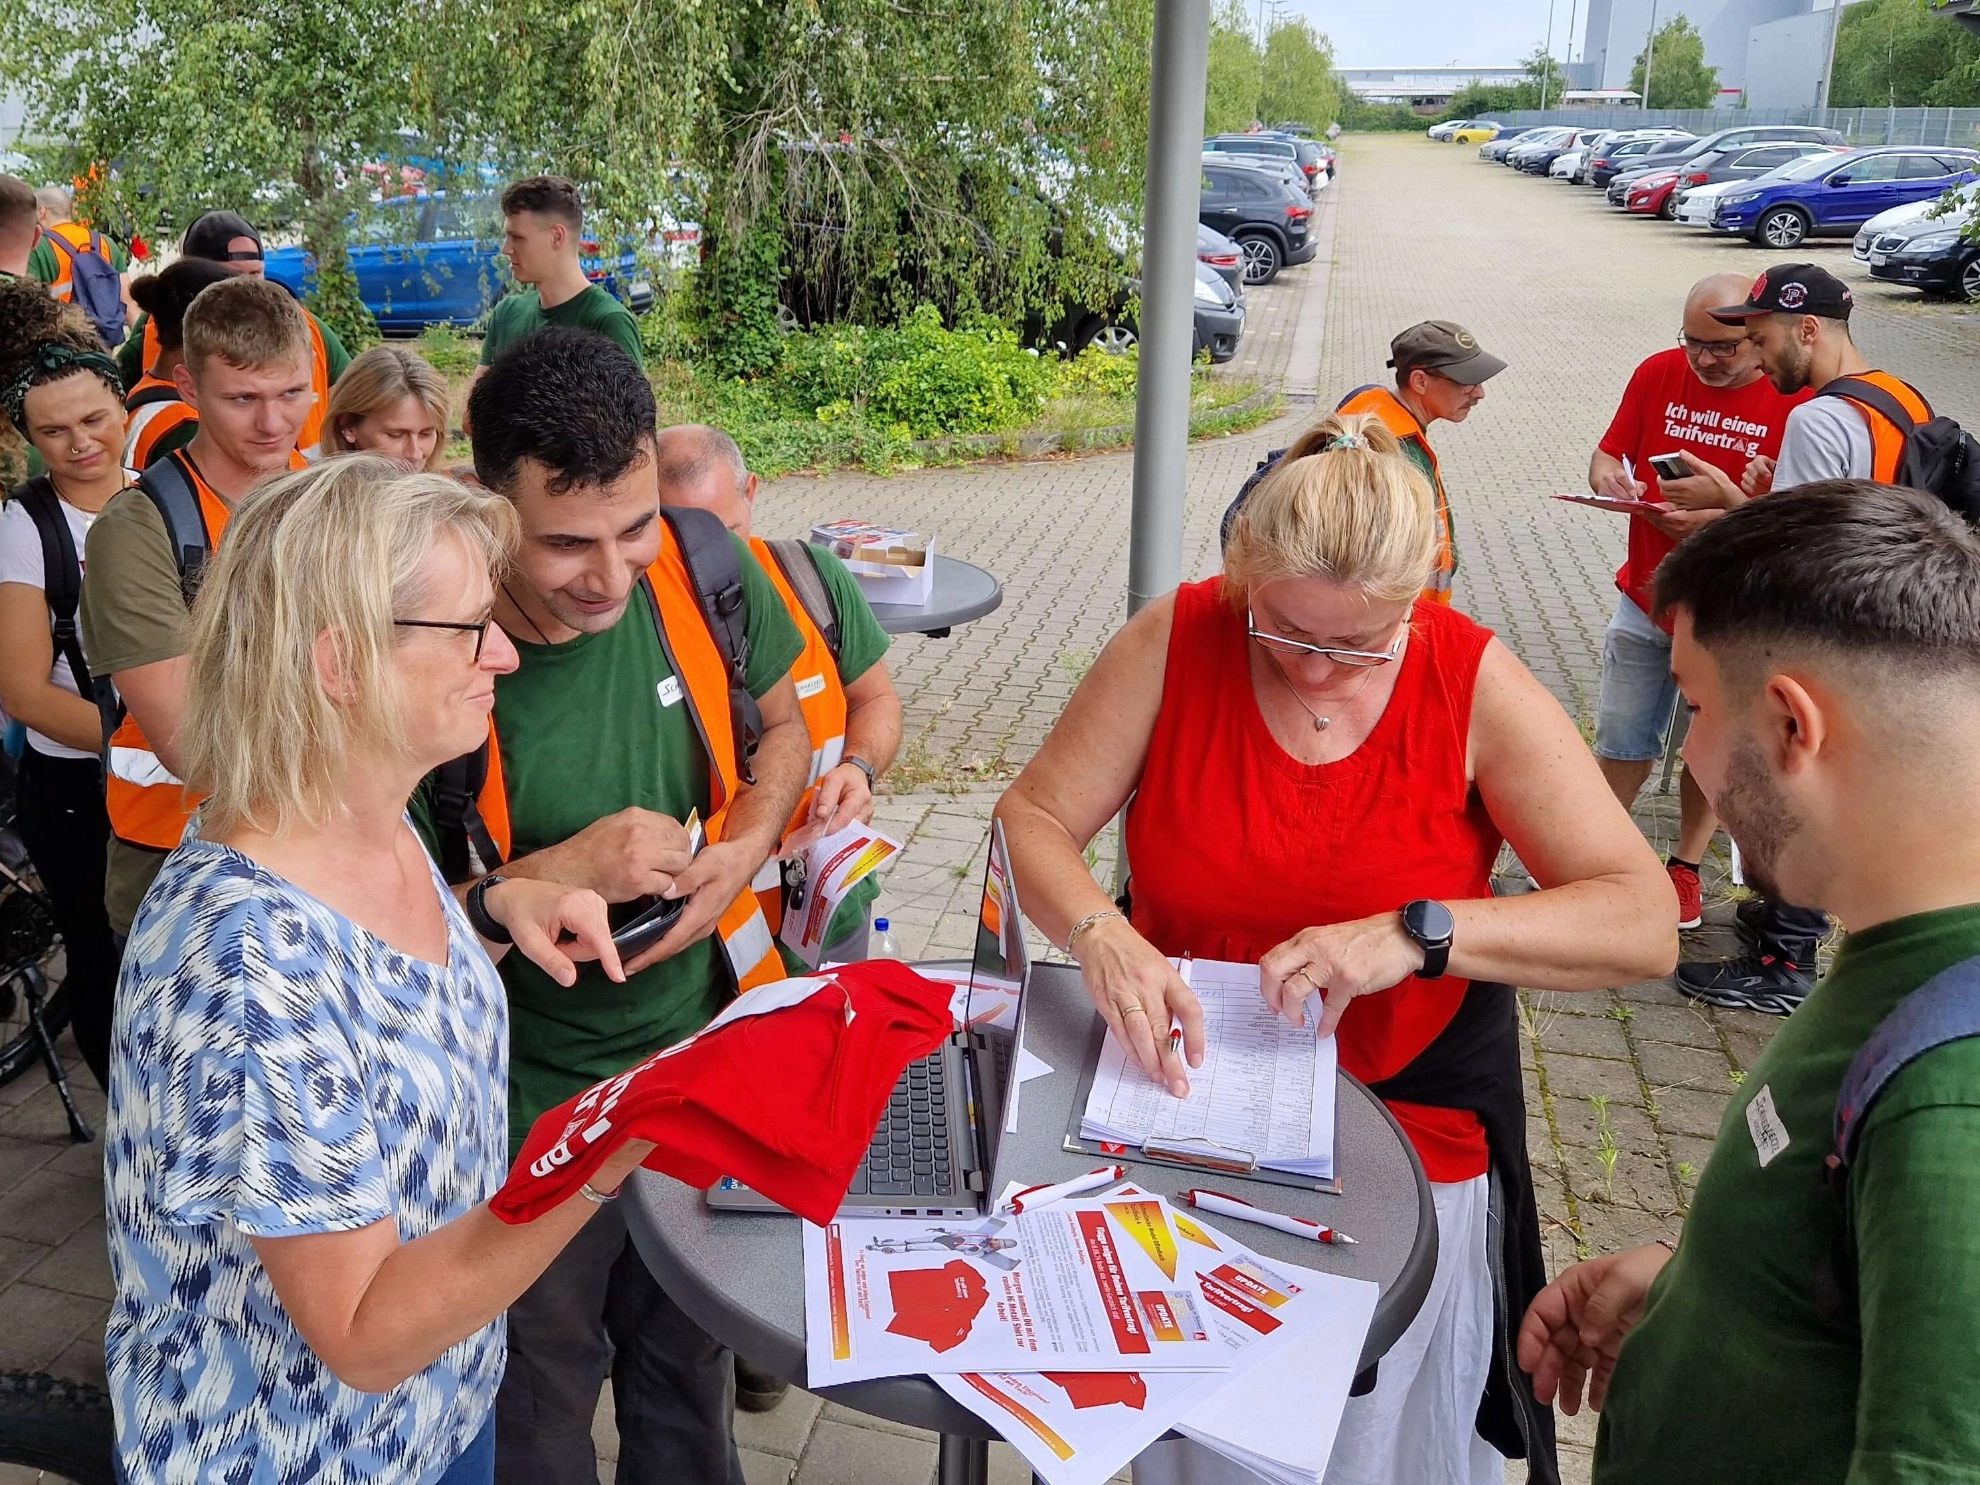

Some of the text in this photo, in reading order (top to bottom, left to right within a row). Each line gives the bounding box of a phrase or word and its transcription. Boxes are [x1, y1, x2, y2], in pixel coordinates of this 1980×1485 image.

[1664, 401, 1768, 438] Ich will einen
[1102, 1245, 1113, 1264] zeigen
[1108, 1264, 1118, 1274] für
[1002, 1276, 1012, 1295] coolen
[1111, 1274, 1123, 1295] Deinen
[1234, 1274, 1268, 1295] UPDATE
[997, 1302, 1008, 1321] Arbeit!
[1009, 1303, 1020, 1321] Metall
[1012, 1272, 1037, 1351] Morgen kommst DU mit dem
[1119, 1297, 1138, 1333] Tarifvertrag!
[1156, 1304, 1173, 1328] UPDATE
[1013, 1323, 1023, 1336] Shirt
[1016, 1338, 1025, 1347] zur
